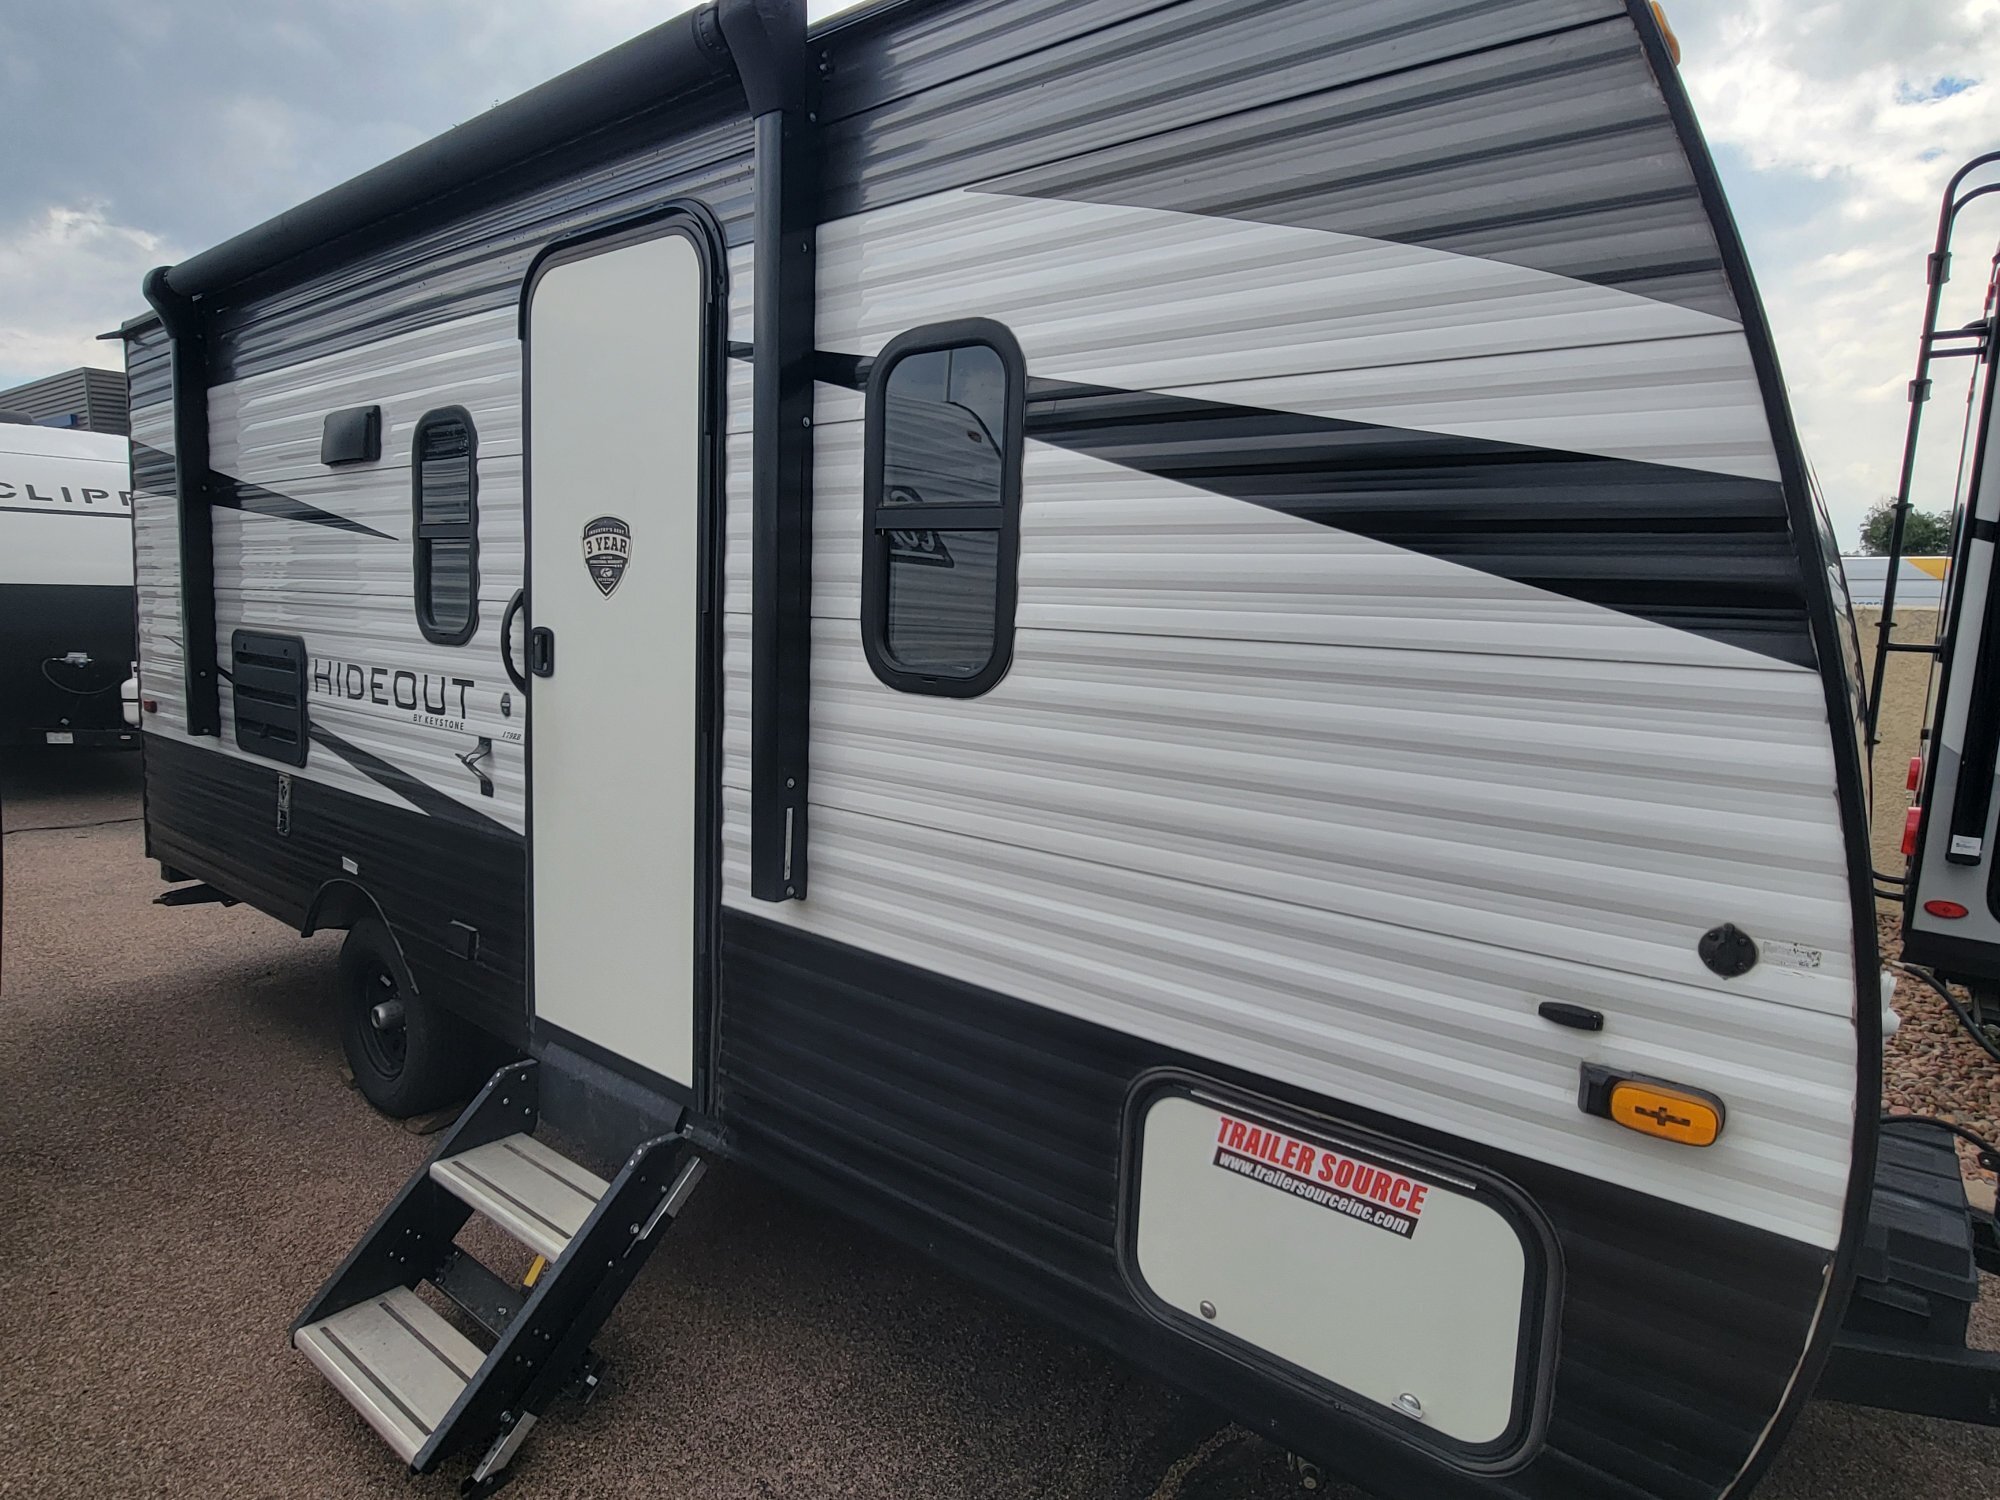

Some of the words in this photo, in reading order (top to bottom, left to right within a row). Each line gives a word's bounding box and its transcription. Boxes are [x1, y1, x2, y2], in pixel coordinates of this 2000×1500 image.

[586, 540, 593, 554] 3
[595, 536, 627, 554] YEAR
[314, 658, 475, 720] HIDEOUT
[413, 713, 423, 722] BY
[424, 715, 465, 731] KEYSTONE
[1217, 1116, 1316, 1176] TRAILER
[1318, 1152, 1429, 1216] SOURCE
[1218, 1151, 1411, 1235] www.trailersourceinc.com
